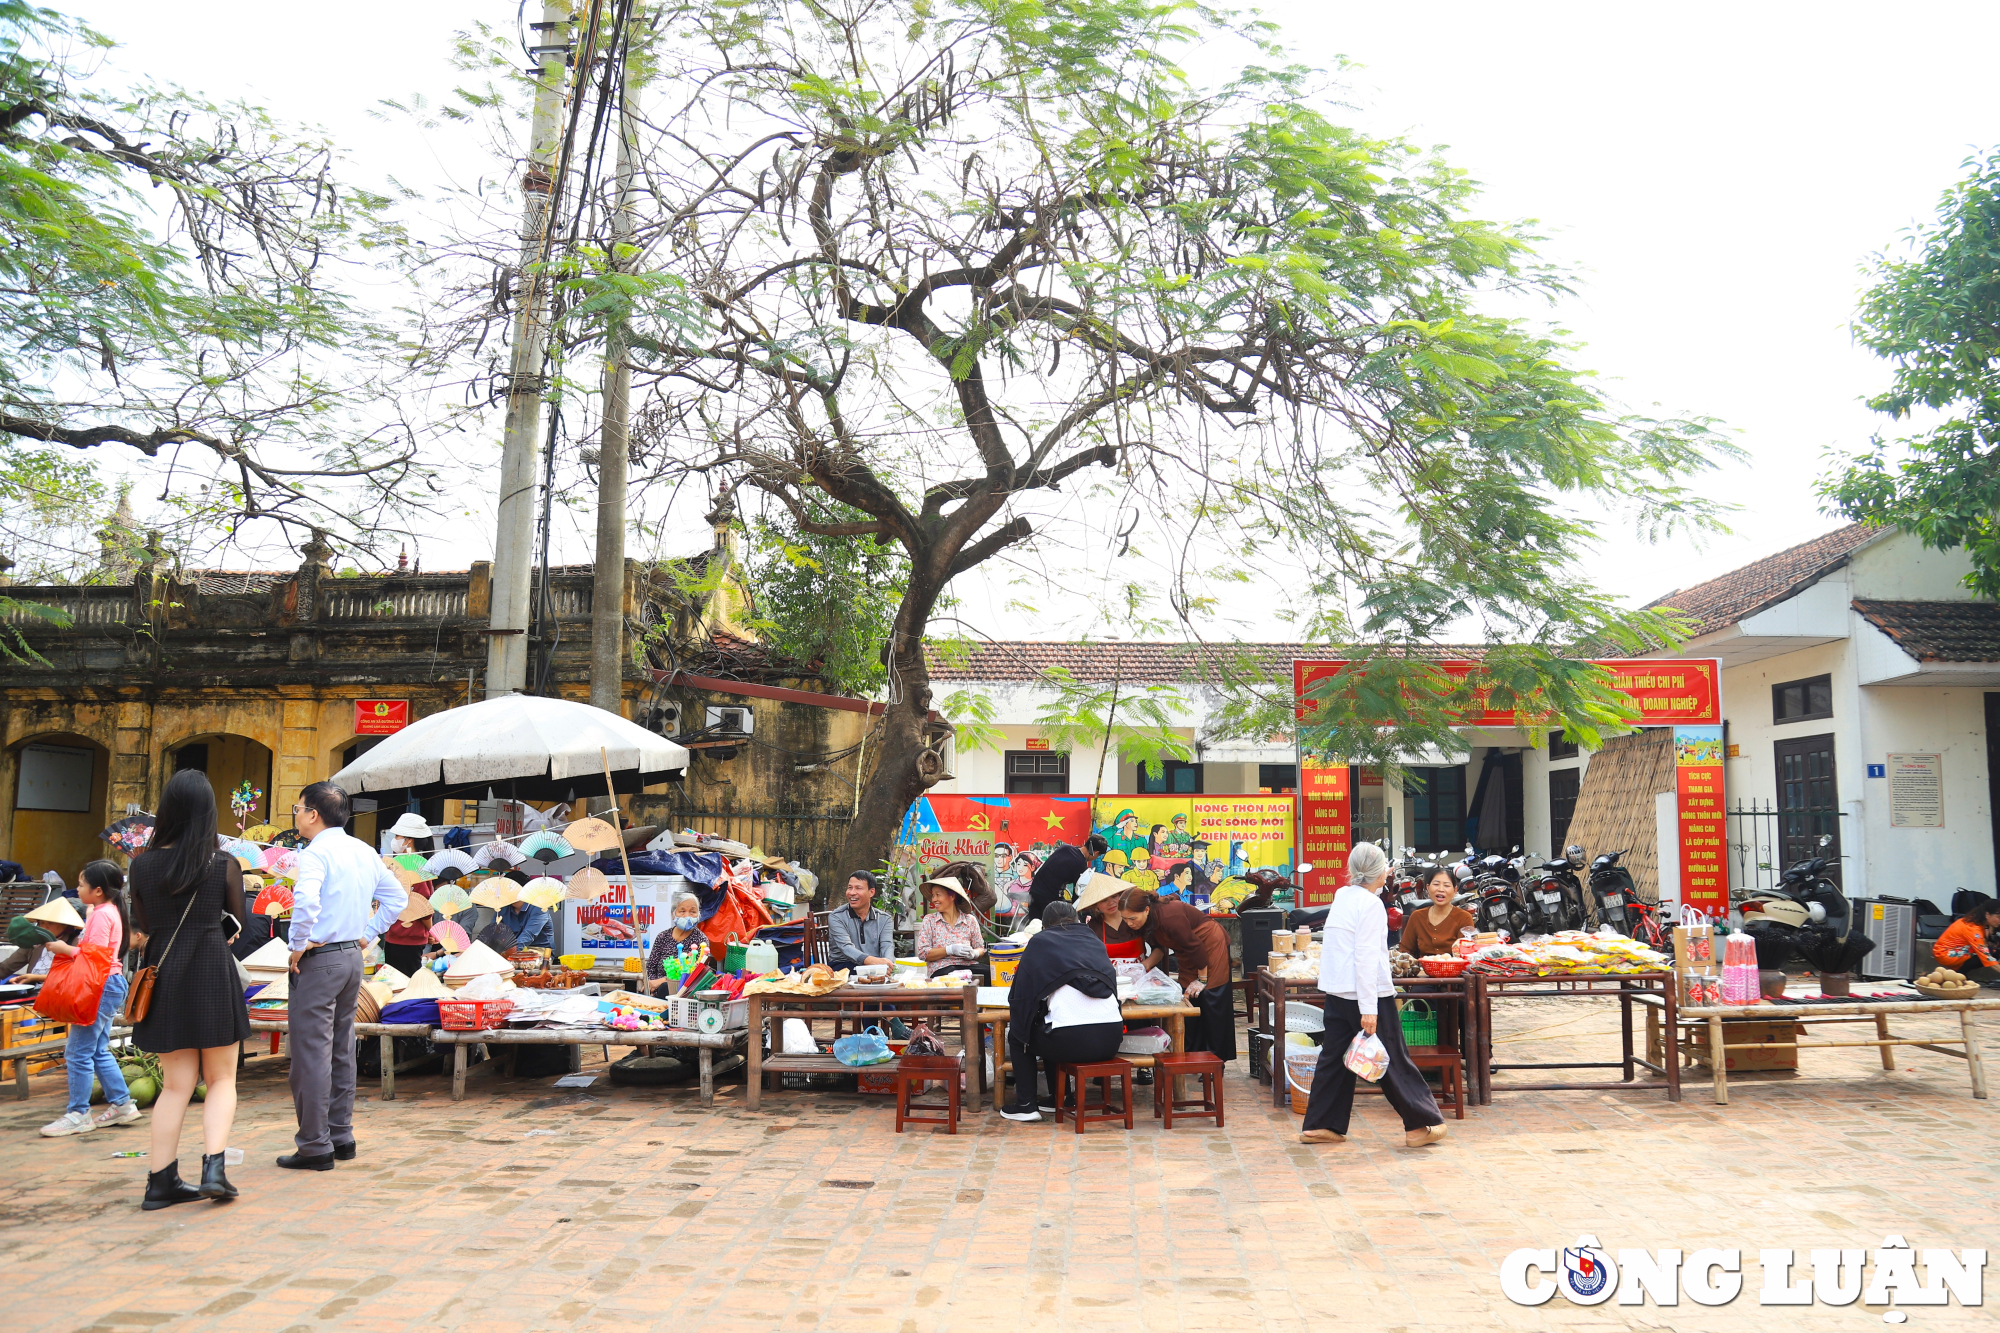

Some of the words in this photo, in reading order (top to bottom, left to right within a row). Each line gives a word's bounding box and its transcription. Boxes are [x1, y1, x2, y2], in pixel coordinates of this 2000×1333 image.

[1634, 671, 1656, 689] THIỂU
[1657, 676, 1670, 689] CHI
[1671, 673, 1685, 689] PHÍ
[1643, 697, 1669, 711] DOANH
[1670, 694, 1698, 713] NGHIỆP
[1688, 771, 1700, 780] TÍCH
[1701, 771, 1712, 782] CỰC
[1873, 766, 1879, 776] 1
[1313, 774, 1323, 785] XÂY
[1323, 774, 1337, 786] DỰNG
[1688, 785, 1703, 793] THAM
[1704, 785, 1713, 793] GIA
[1308, 790, 1321, 801] NÔNG
[1322, 790, 1334, 801] THÔN
[1334, 789, 1344, 801] MỚI
[1194, 803, 1229, 813] NÔNG
[1232, 803, 1264, 813] THÔN
[1267, 802, 1290, 813] MỚI
[1688, 797, 1699, 806] XÂY
[1699, 798, 1714, 807] DỰNG
[1314, 807, 1327, 818] NÂNG
[1328, 808, 1338, 818] CAO
[1681, 811, 1696, 819] NÔNG
[1697, 811, 1711, 819] THÔN
[1712, 811, 1722, 819] MỚI
[1200, 816, 1222, 827] SỨC
[1225, 815, 1258, 827] SỐNG
[1261, 816, 1284, 827] MỚI
[1308, 824, 1314, 835] LÀ
[1314, 824, 1329, 835] TRÁCH
[1330, 824, 1345, 836] NHIỆM
[1689, 824, 1704, 833] NÂNG
[1705, 825, 1716, 833] CAO
[1201, 831, 1228, 842] DIỆN
[1231, 832, 1258, 842] MẠO
[1261, 830, 1284, 841] MỚI
[1685, 837, 1693, 846] LÀ
[1693, 837, 1704, 846] GÓP
[1705, 836, 1720, 846] PHẦN
[919, 838, 951, 864] Giải
[952, 838, 990, 856] Khát
[1306, 840, 1316, 852] CỦA
[1316, 840, 1326, 852] CẤP
[1333, 840, 1348, 852] ĐẢNG,
[1690, 850, 1700, 859] XÂY
[1701, 851, 1716, 861] DỰNG
[1312, 858, 1327, 869] CHÍNH
[1327, 857, 1342, 869] QUYỀN
[1688, 863, 1707, 872] ĐƯỜNG
[1707, 863, 1719, 872] LÂM
[1319, 875, 1326, 886] VÀ
[1326, 874, 1336, 886] CỦA
[1691, 877, 1704, 886] GIÀU
[1705, 878, 1717, 887] ĐẸP,
[1690, 890, 1702, 899] VĂN
[1702, 891, 1719, 899] MINH!
[576, 901, 610, 925] NƯỚC
